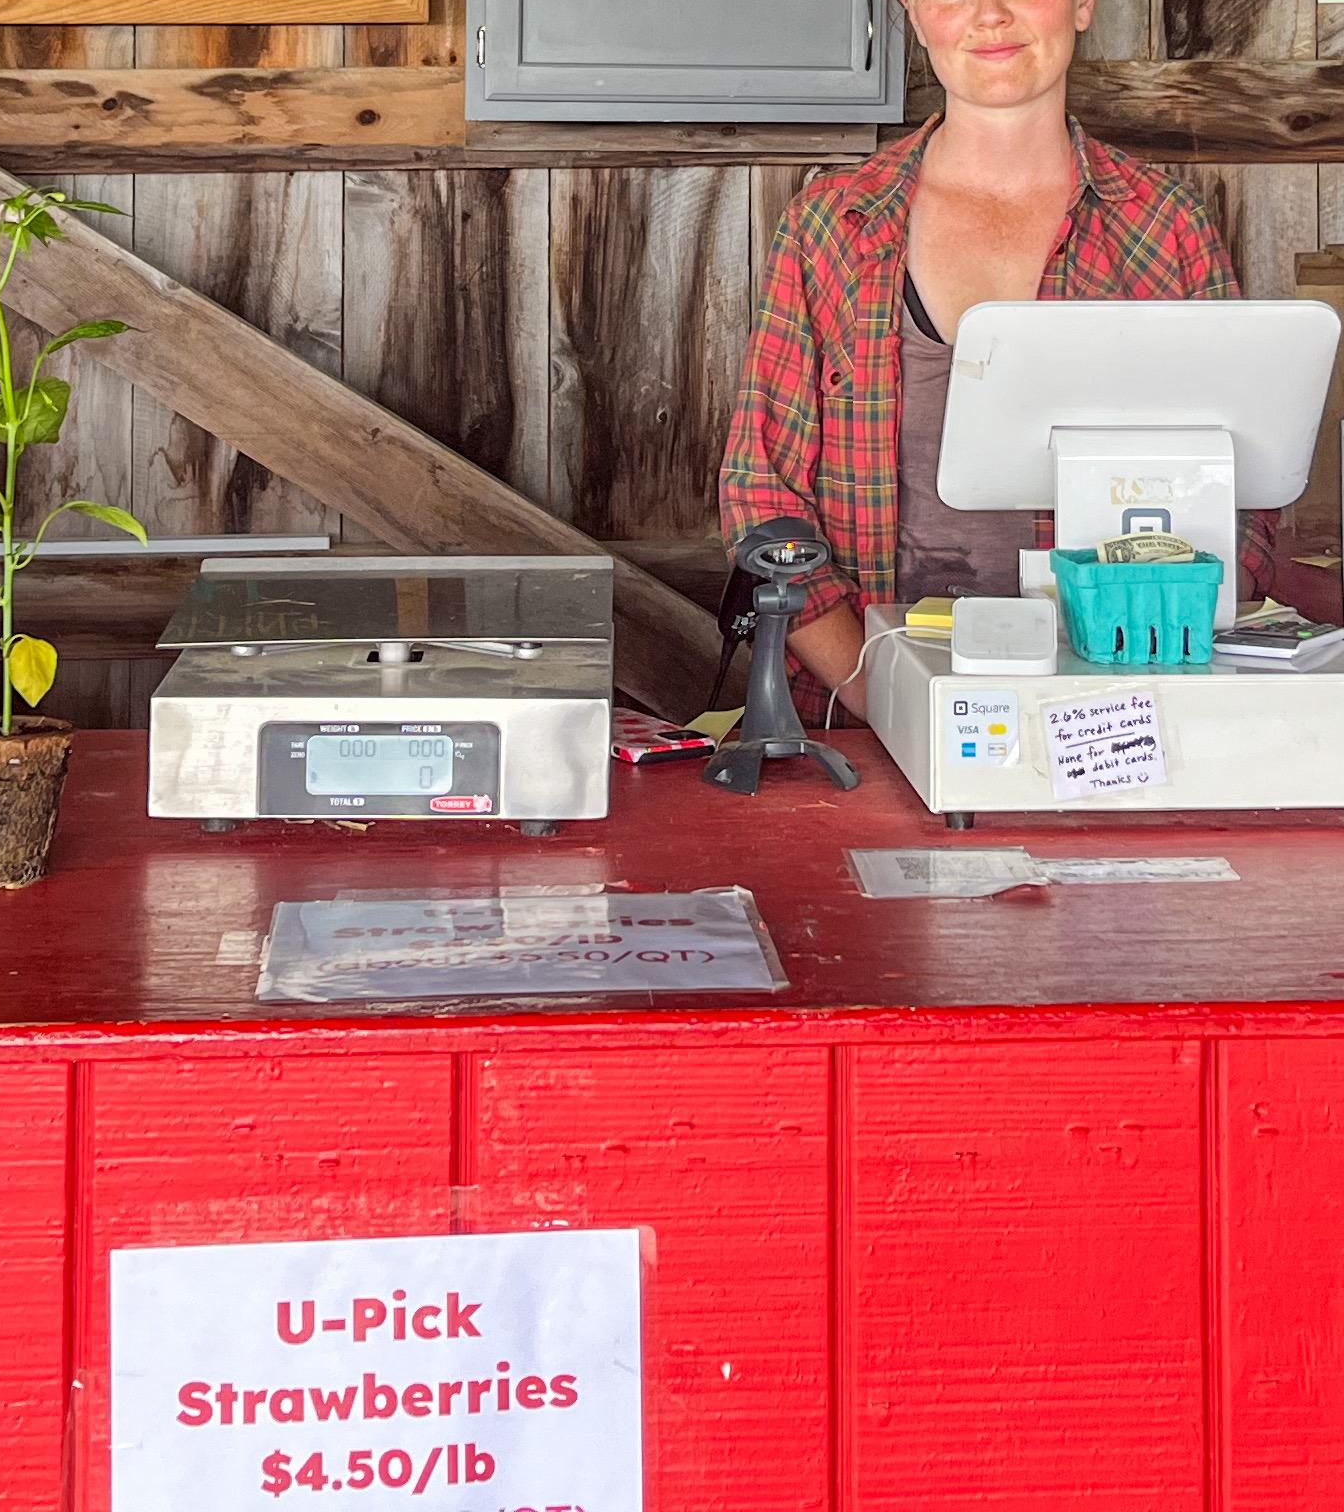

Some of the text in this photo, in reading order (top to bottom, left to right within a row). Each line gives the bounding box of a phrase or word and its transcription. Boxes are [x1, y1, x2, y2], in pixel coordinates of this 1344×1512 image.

[971, 702, 1010, 716] Square
[1050, 696, 1152, 724] 2.6% service fee
[957, 726, 979, 734] VISA
[1055, 715, 1152, 742] for credit cards
[1058, 745, 1105, 765] None for
[1093, 757, 1119, 772] debit
[1090, 776, 1131, 789] Thanks
[277, 1289, 482, 1345] U-Pick
[177, 1361, 579, 1426] Strawberries
[261, 1444, 495, 1498] $4.50/lb
